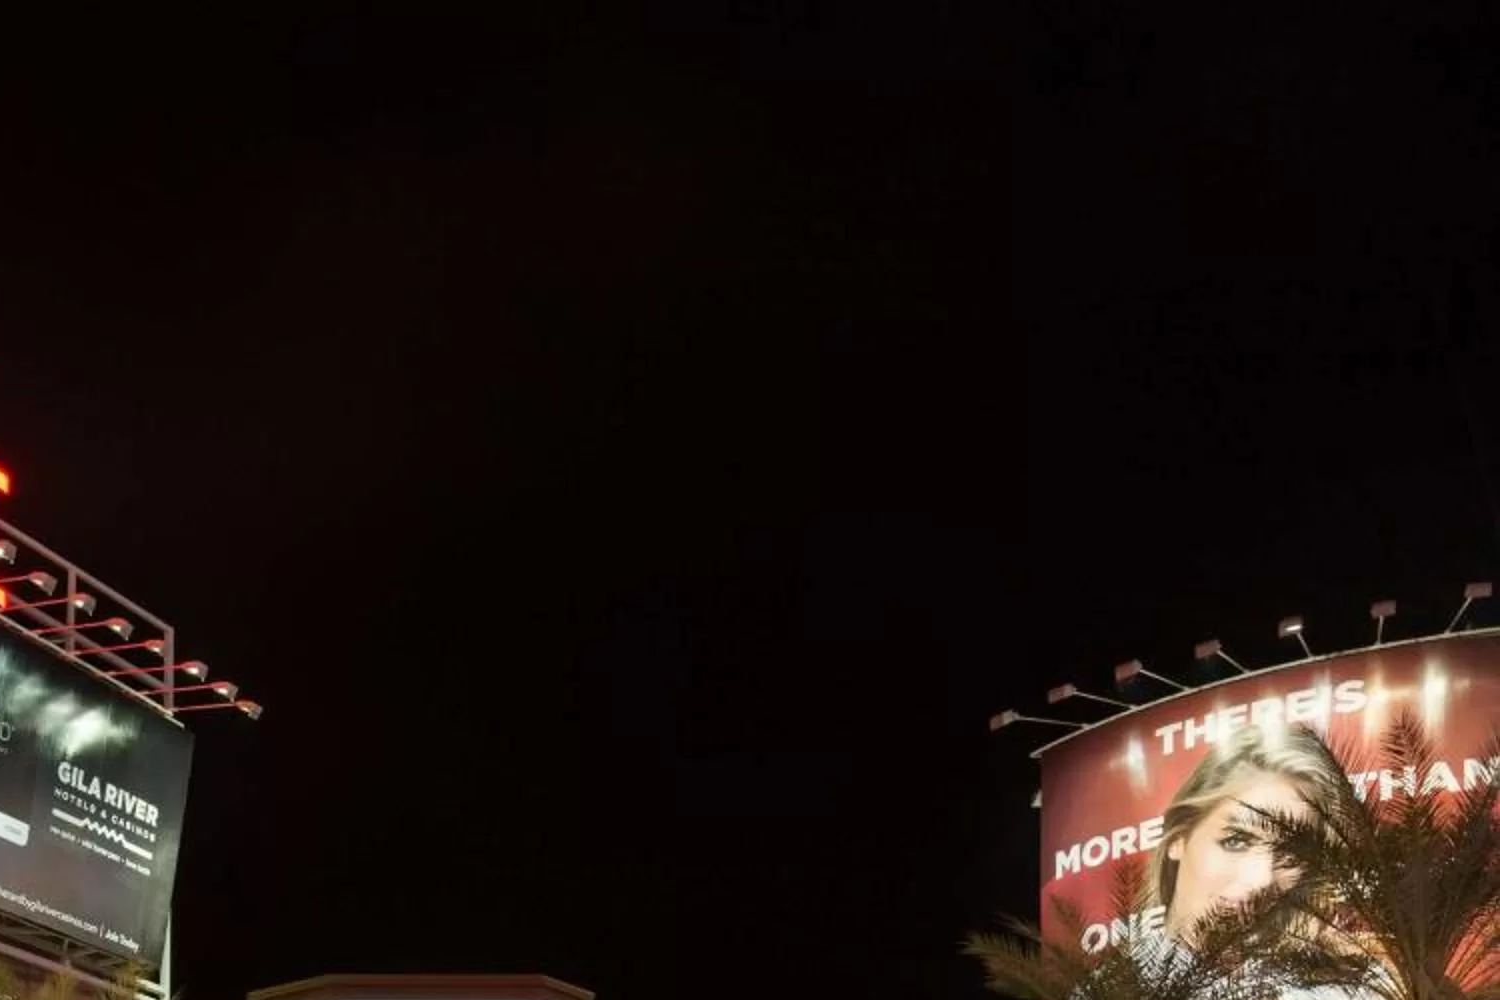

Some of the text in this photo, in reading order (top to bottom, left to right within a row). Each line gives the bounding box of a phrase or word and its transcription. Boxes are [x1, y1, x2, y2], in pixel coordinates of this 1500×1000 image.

[57, 760, 160, 829] GILA RIVER
[1054, 814, 1166, 881] MORE
[1080, 904, 1168, 956] ONE
